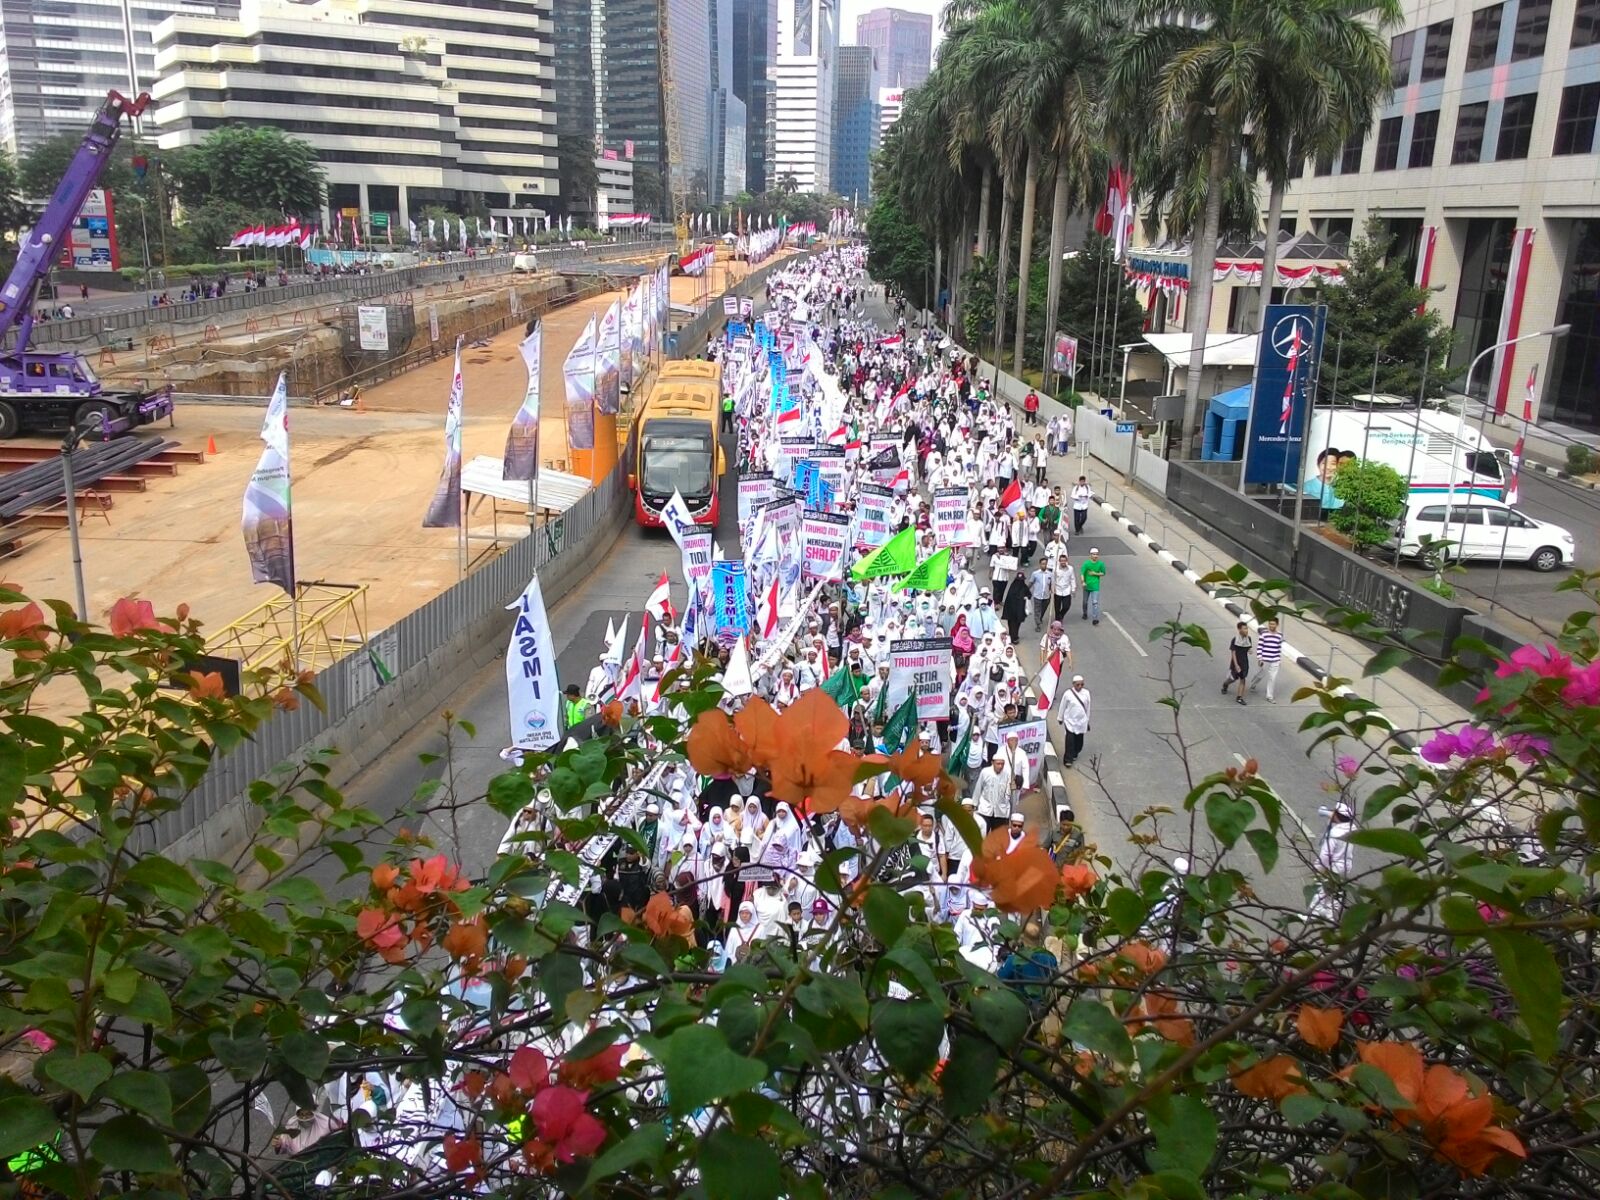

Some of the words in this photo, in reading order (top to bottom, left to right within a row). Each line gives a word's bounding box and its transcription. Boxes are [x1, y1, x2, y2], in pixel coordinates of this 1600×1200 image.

[1117, 424, 1135, 432] TAXI
[740, 484, 759, 493] TAUHID
[865, 508, 884, 521] TIDAK
[938, 511, 964, 521] MENJAGA
[805, 523, 828, 535] TAUHID
[828, 527, 839, 536] ITU
[806, 538, 843, 549] MENEGAKKAN
[805, 546, 841, 563] SHALAT
[723, 575, 737, 626] HASMI
[894, 657, 925, 668] TAUHID
[926, 655, 939, 666] ITU
[913, 670, 938, 684] SETIA
[907, 682, 943, 696] KEPADA
[1026, 727, 1038, 740] ITU
